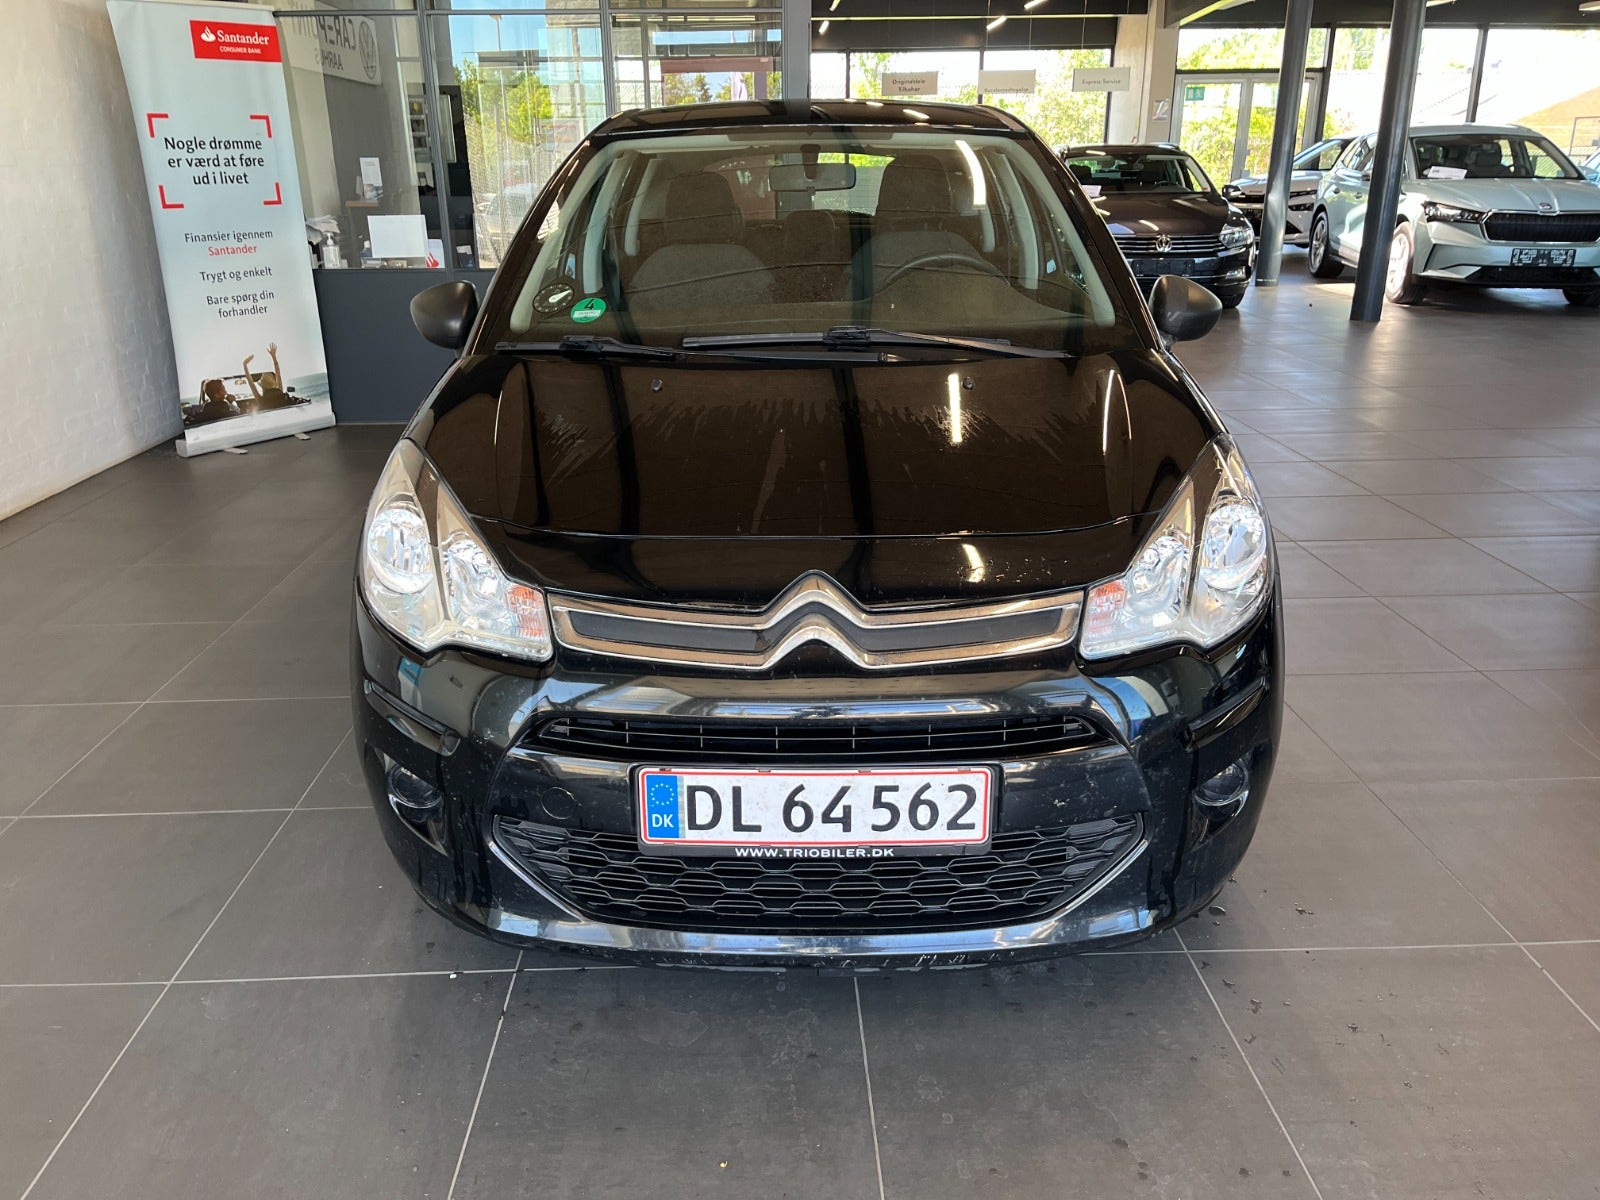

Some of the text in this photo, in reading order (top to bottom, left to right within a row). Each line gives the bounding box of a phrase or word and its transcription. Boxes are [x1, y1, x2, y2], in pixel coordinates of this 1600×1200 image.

[216, 29, 270, 45] Santander
[219, 45, 247, 54] CONSUMER
[164, 136, 263, 154] Nogle drømme
[167, 153, 265, 168] er værd at føre
[192, 170, 249, 185] ud i livet
[184, 229, 273, 244] Finansier igennem
[208, 244, 257, 257] Santander
[199, 266, 273, 283] Trygt og enkelt
[206, 290, 275, 306] Bare spørg din
[584, 298, 594, 310] 4
[218, 304, 268, 319] forhandler
[686, 781, 978, 834] DL 64 562
[651, 813, 675, 829] DK
[734, 847, 895, 859] WWW.TRIOBILER.DK
